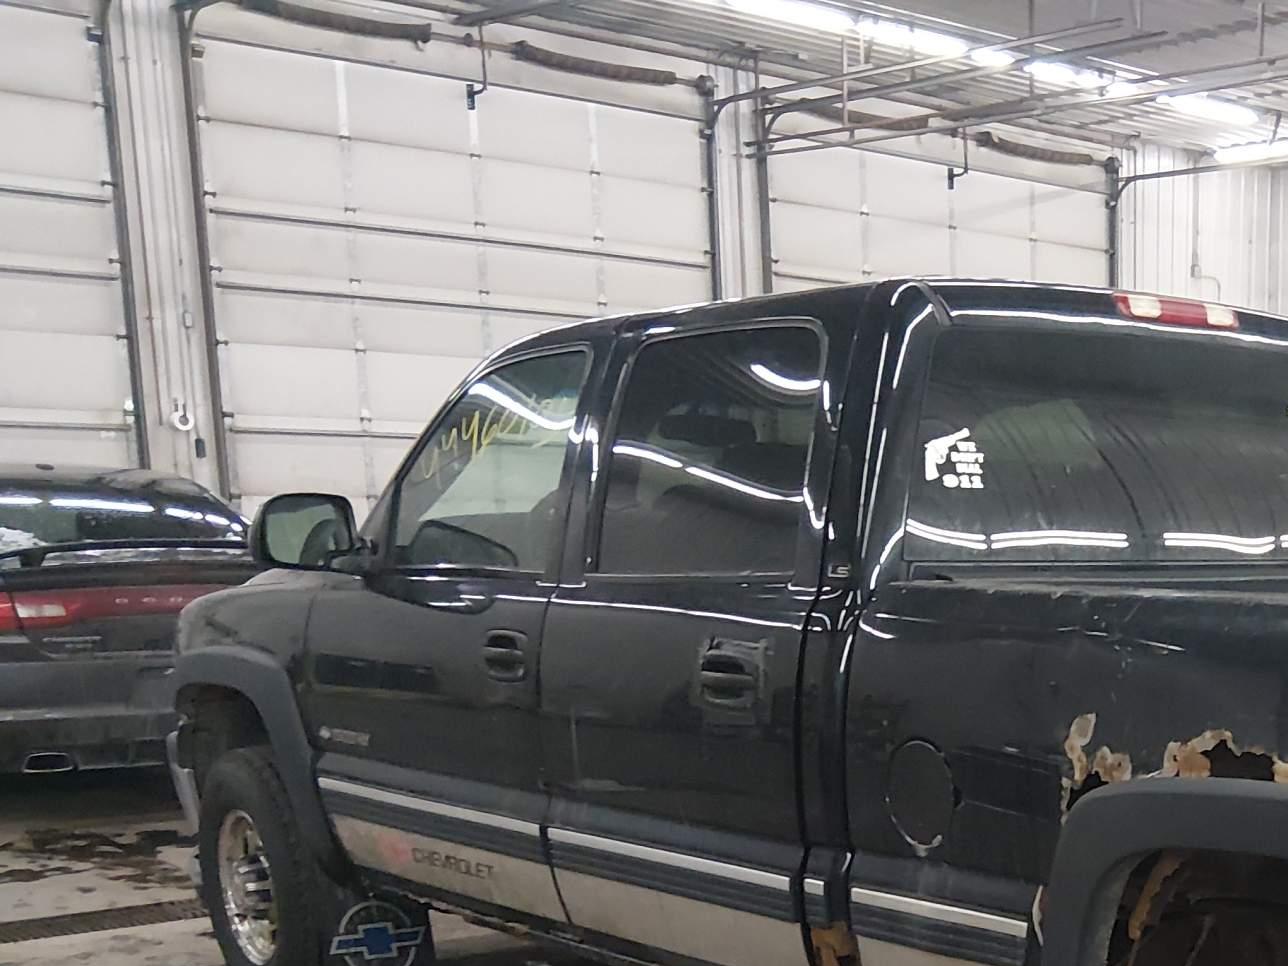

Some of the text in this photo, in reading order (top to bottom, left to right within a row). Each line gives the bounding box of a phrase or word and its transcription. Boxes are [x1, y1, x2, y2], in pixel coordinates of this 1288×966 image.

[942, 473, 985, 489] 911
[828, 563, 850, 578] LS
[411, 846, 495, 880] CHEVROLET
